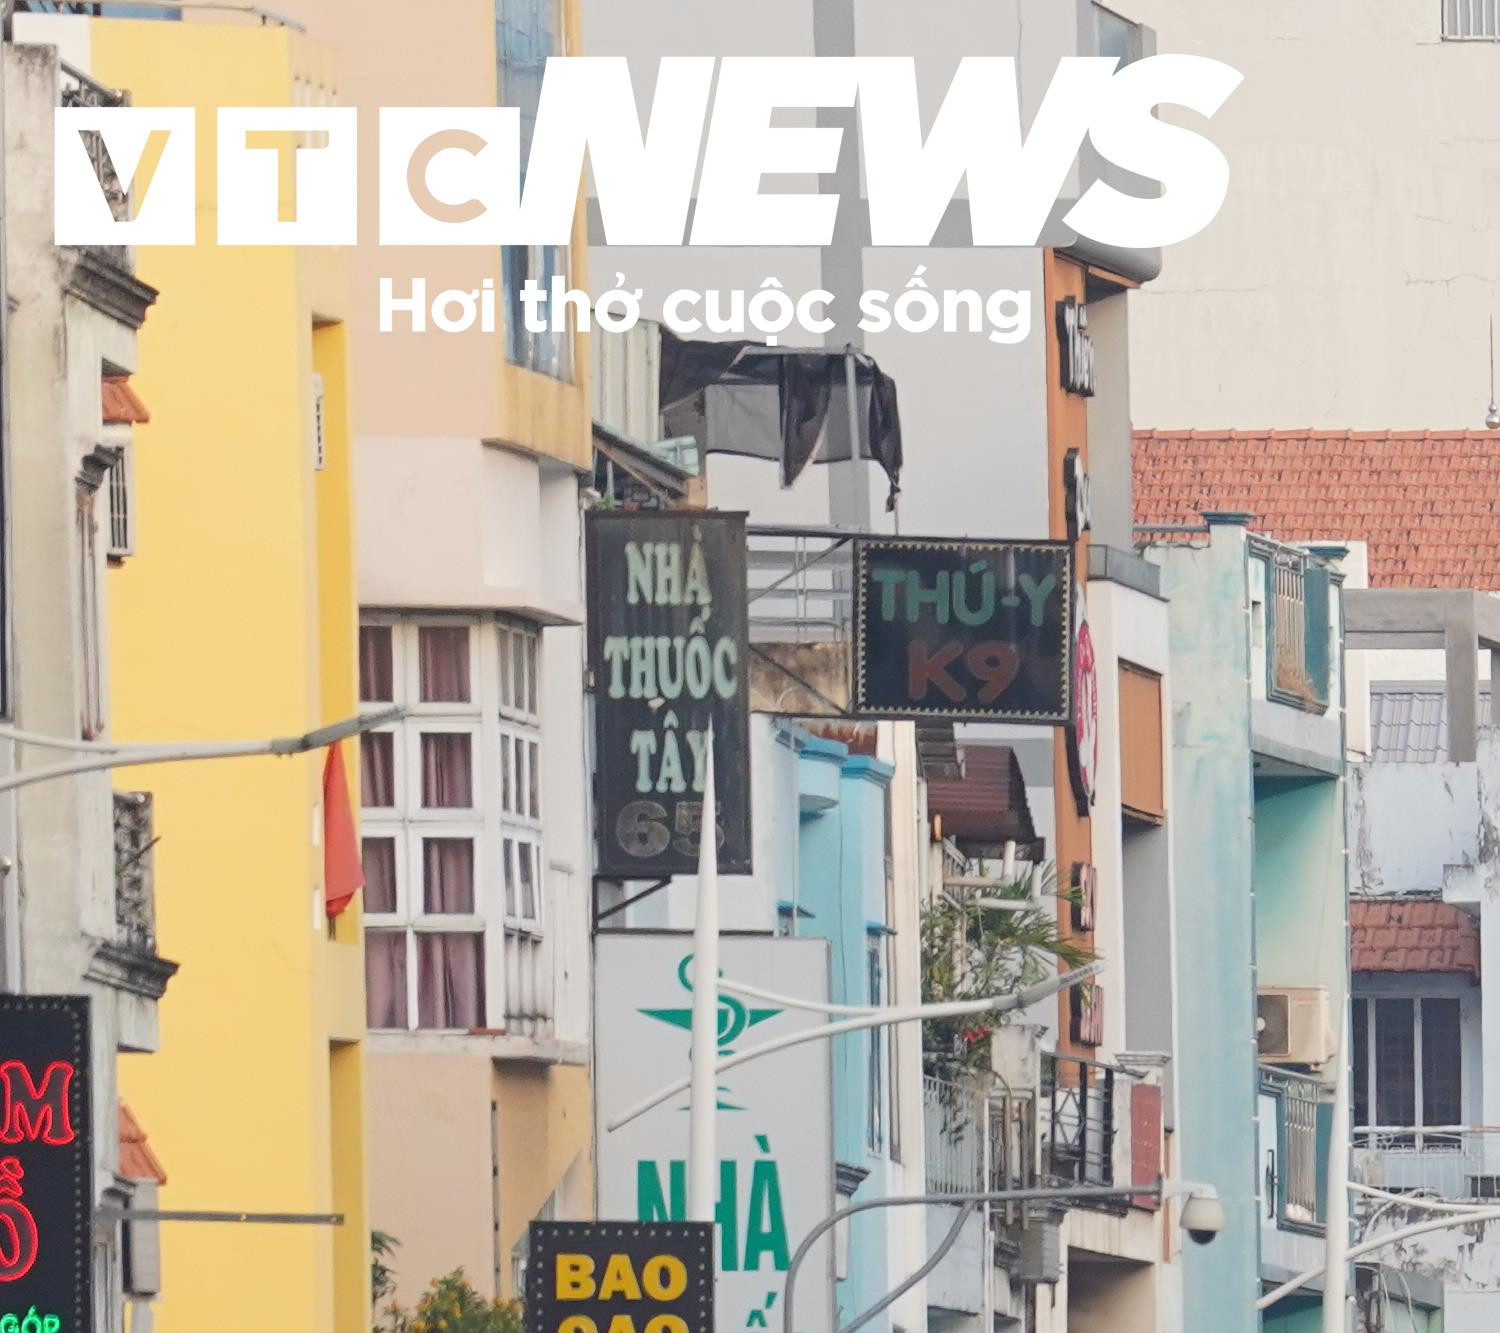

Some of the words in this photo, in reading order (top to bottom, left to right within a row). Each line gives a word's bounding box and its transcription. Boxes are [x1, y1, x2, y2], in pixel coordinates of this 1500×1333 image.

[872, 560, 1057, 627] THÚ-Y
[603, 605, 738, 700] THUỐC
[907, 640, 1020, 702] K9
[631, 711, 715, 793] TÂY
[555, 1254, 688, 1301] BAO
